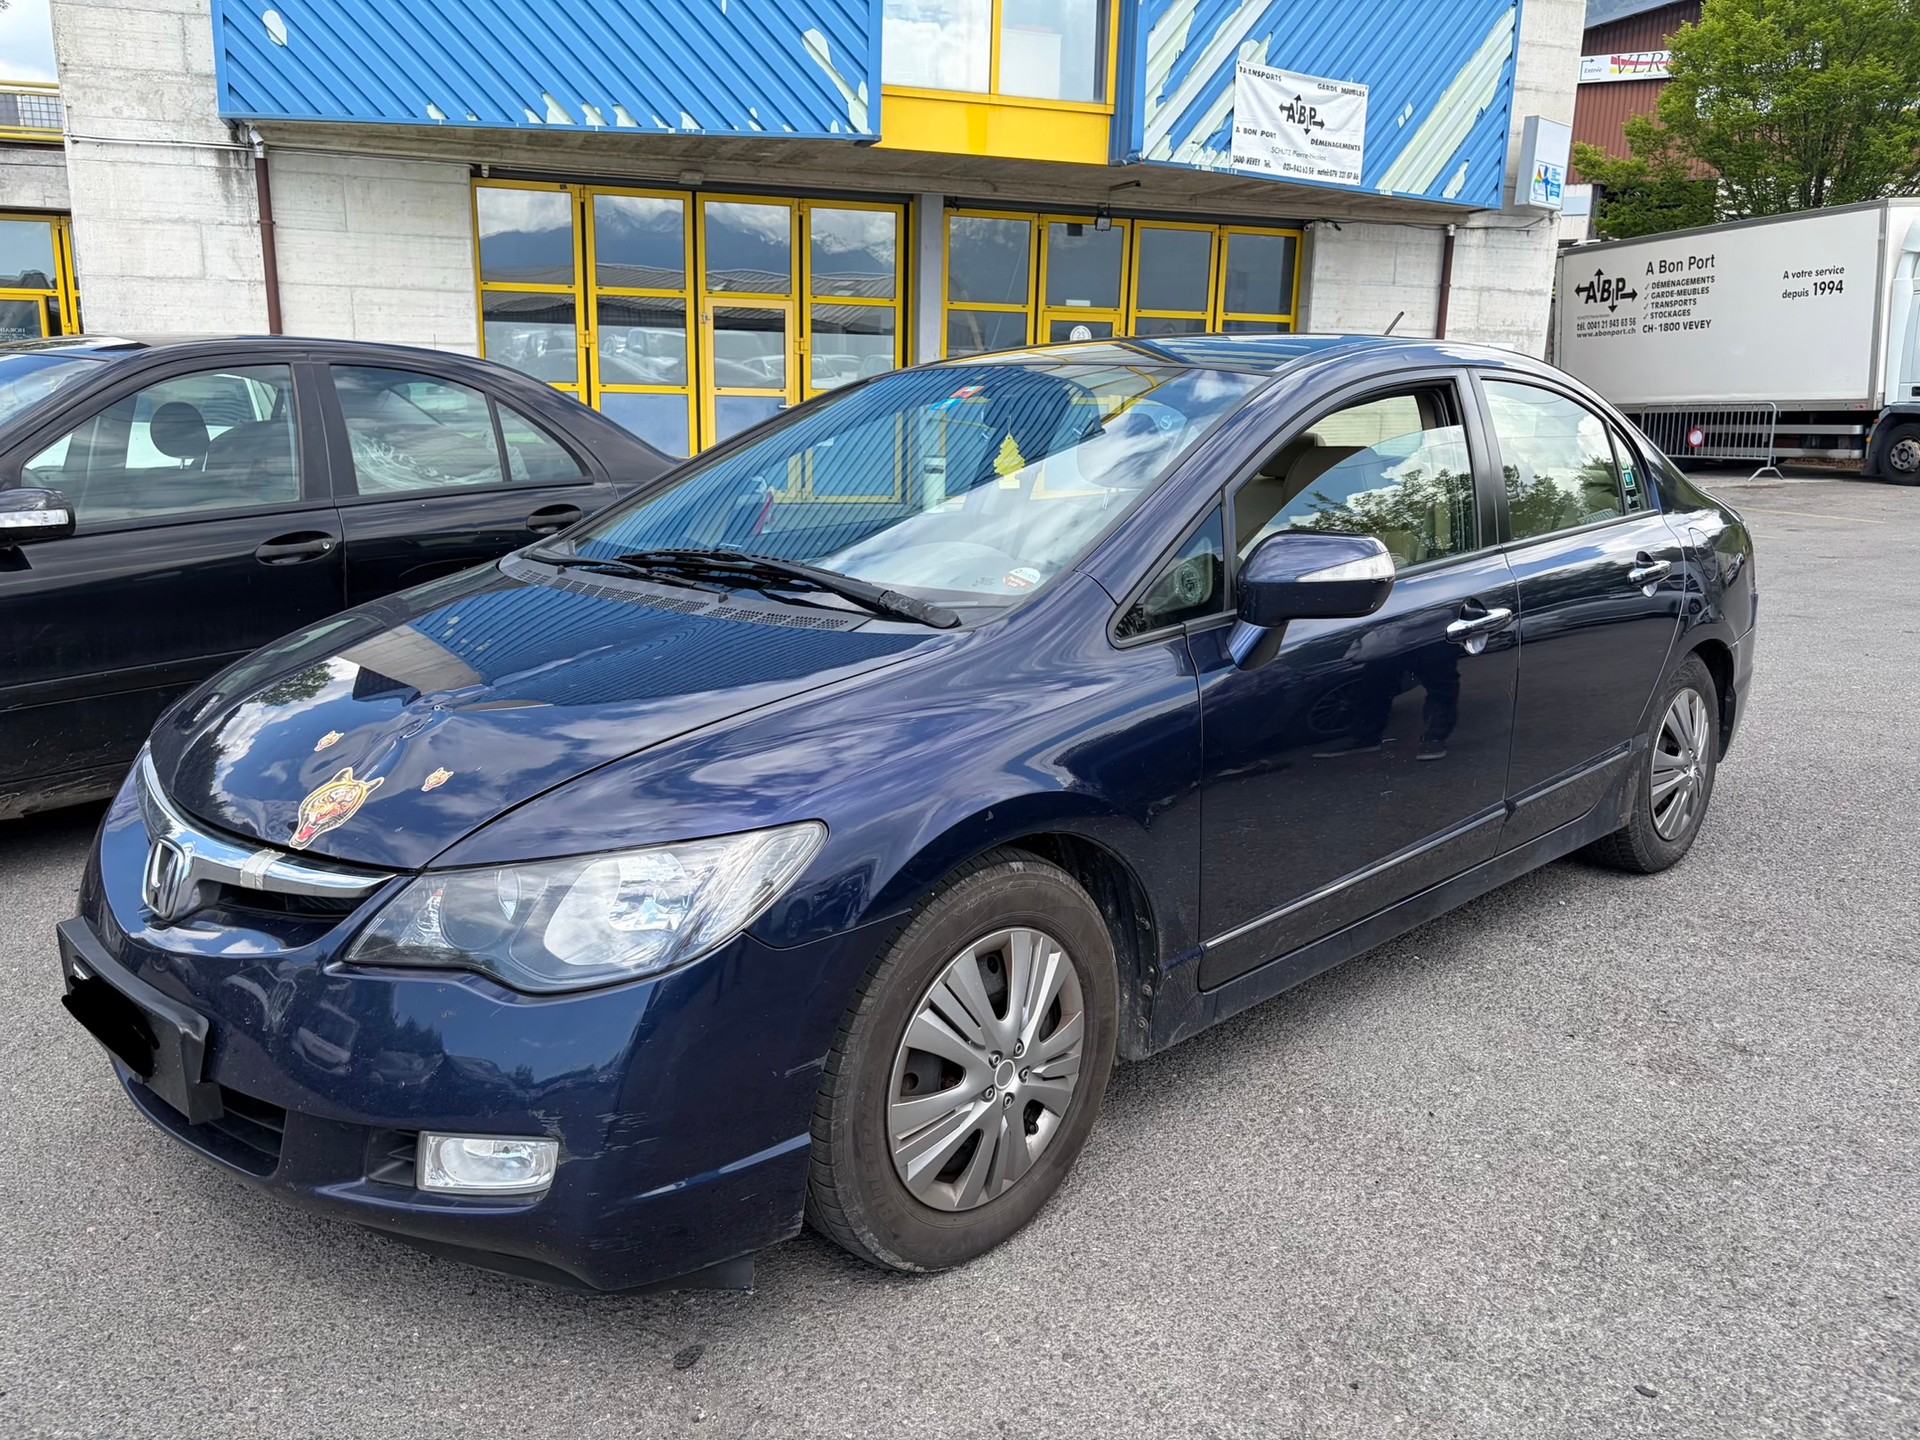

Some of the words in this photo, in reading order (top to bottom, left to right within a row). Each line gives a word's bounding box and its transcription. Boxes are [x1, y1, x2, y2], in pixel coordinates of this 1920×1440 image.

[1239, 66, 1282, 82] TRANSPORTS
[1317, 83, 1338, 93] GARDE
[1286, 103, 1317, 126] ABP
[1243, 126, 1258, 136] BON
[1260, 130, 1277, 139] PORT
[1645, 261, 1654, 276] A
[1659, 259, 1684, 274] Bon
[1688, 254, 1715, 271] Port
[1782, 270, 1789, 280] A
[1791, 269, 1813, 279] votre
[1814, 264, 1845, 277] service
[1584, 277, 1626, 305] ABP
[1650, 286, 1710, 300] GARDE-MEUBLES
[1781, 288, 1809, 300] depuis
[1812, 279, 1844, 296] 1994
[1651, 298, 1697, 310] TRANSPORTS
[1650, 308, 1691, 320] STOCKAGES
[1601, 319, 1608, 329] 21
[1682, 319, 1712, 331] VEVEY
[1576, 327, 1637, 338] www.abonport.ch
